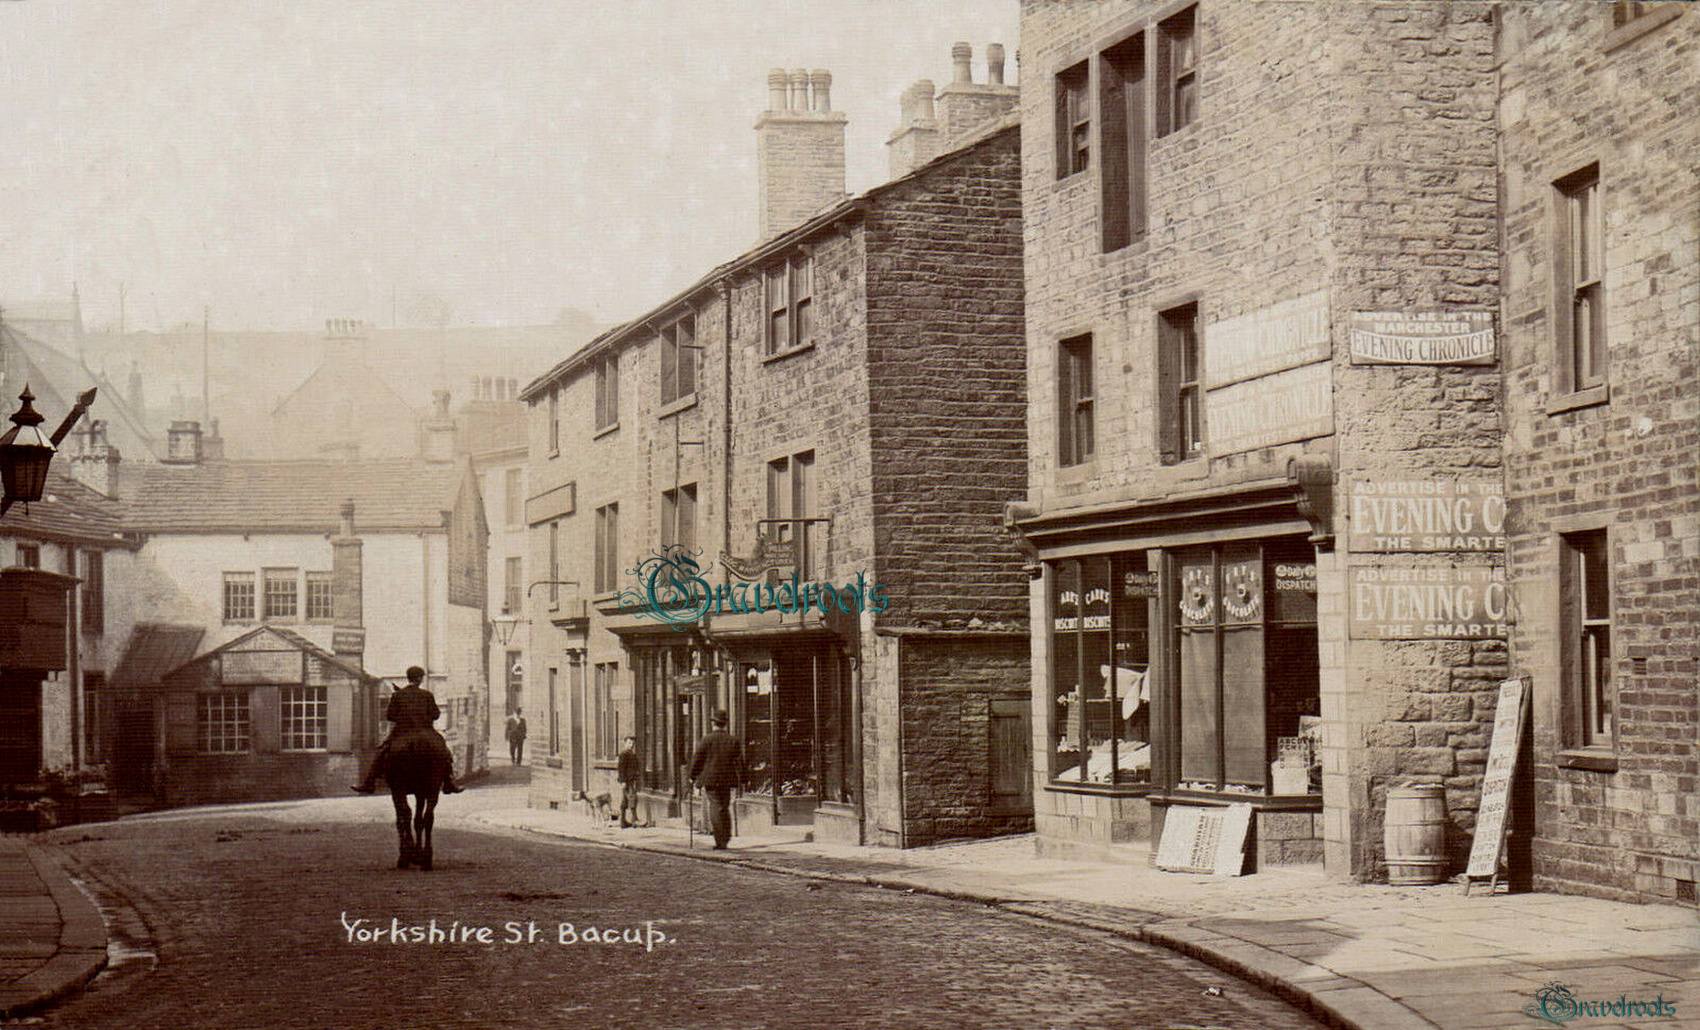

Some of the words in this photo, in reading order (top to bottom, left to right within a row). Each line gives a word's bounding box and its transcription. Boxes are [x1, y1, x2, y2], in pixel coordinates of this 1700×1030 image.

[1374, 322, 1471, 333] MANCHESTER
[1351, 330, 1413, 360] EVENING
[1419, 331, 1494, 361] CHRONICLE
[1354, 481, 1446, 494] ADVERTISE
[1455, 483, 1469, 494] IN
[1478, 483, 1504, 494] THE
[1354, 495, 1473, 534] EVENING
[1374, 536, 1412, 549] THE
[1422, 536, 1506, 549] SMARTE
[1356, 569, 1449, 582] ADVERTISE
[1457, 570, 1471, 581] IN
[1481, 570, 1505, 581] THE
[1276, 579, 1317, 591] DISPATCH
[1355, 583, 1473, 622] EVENING
[1375, 624, 1413, 636] THE
[1423, 623, 1508, 636] SMARTE
